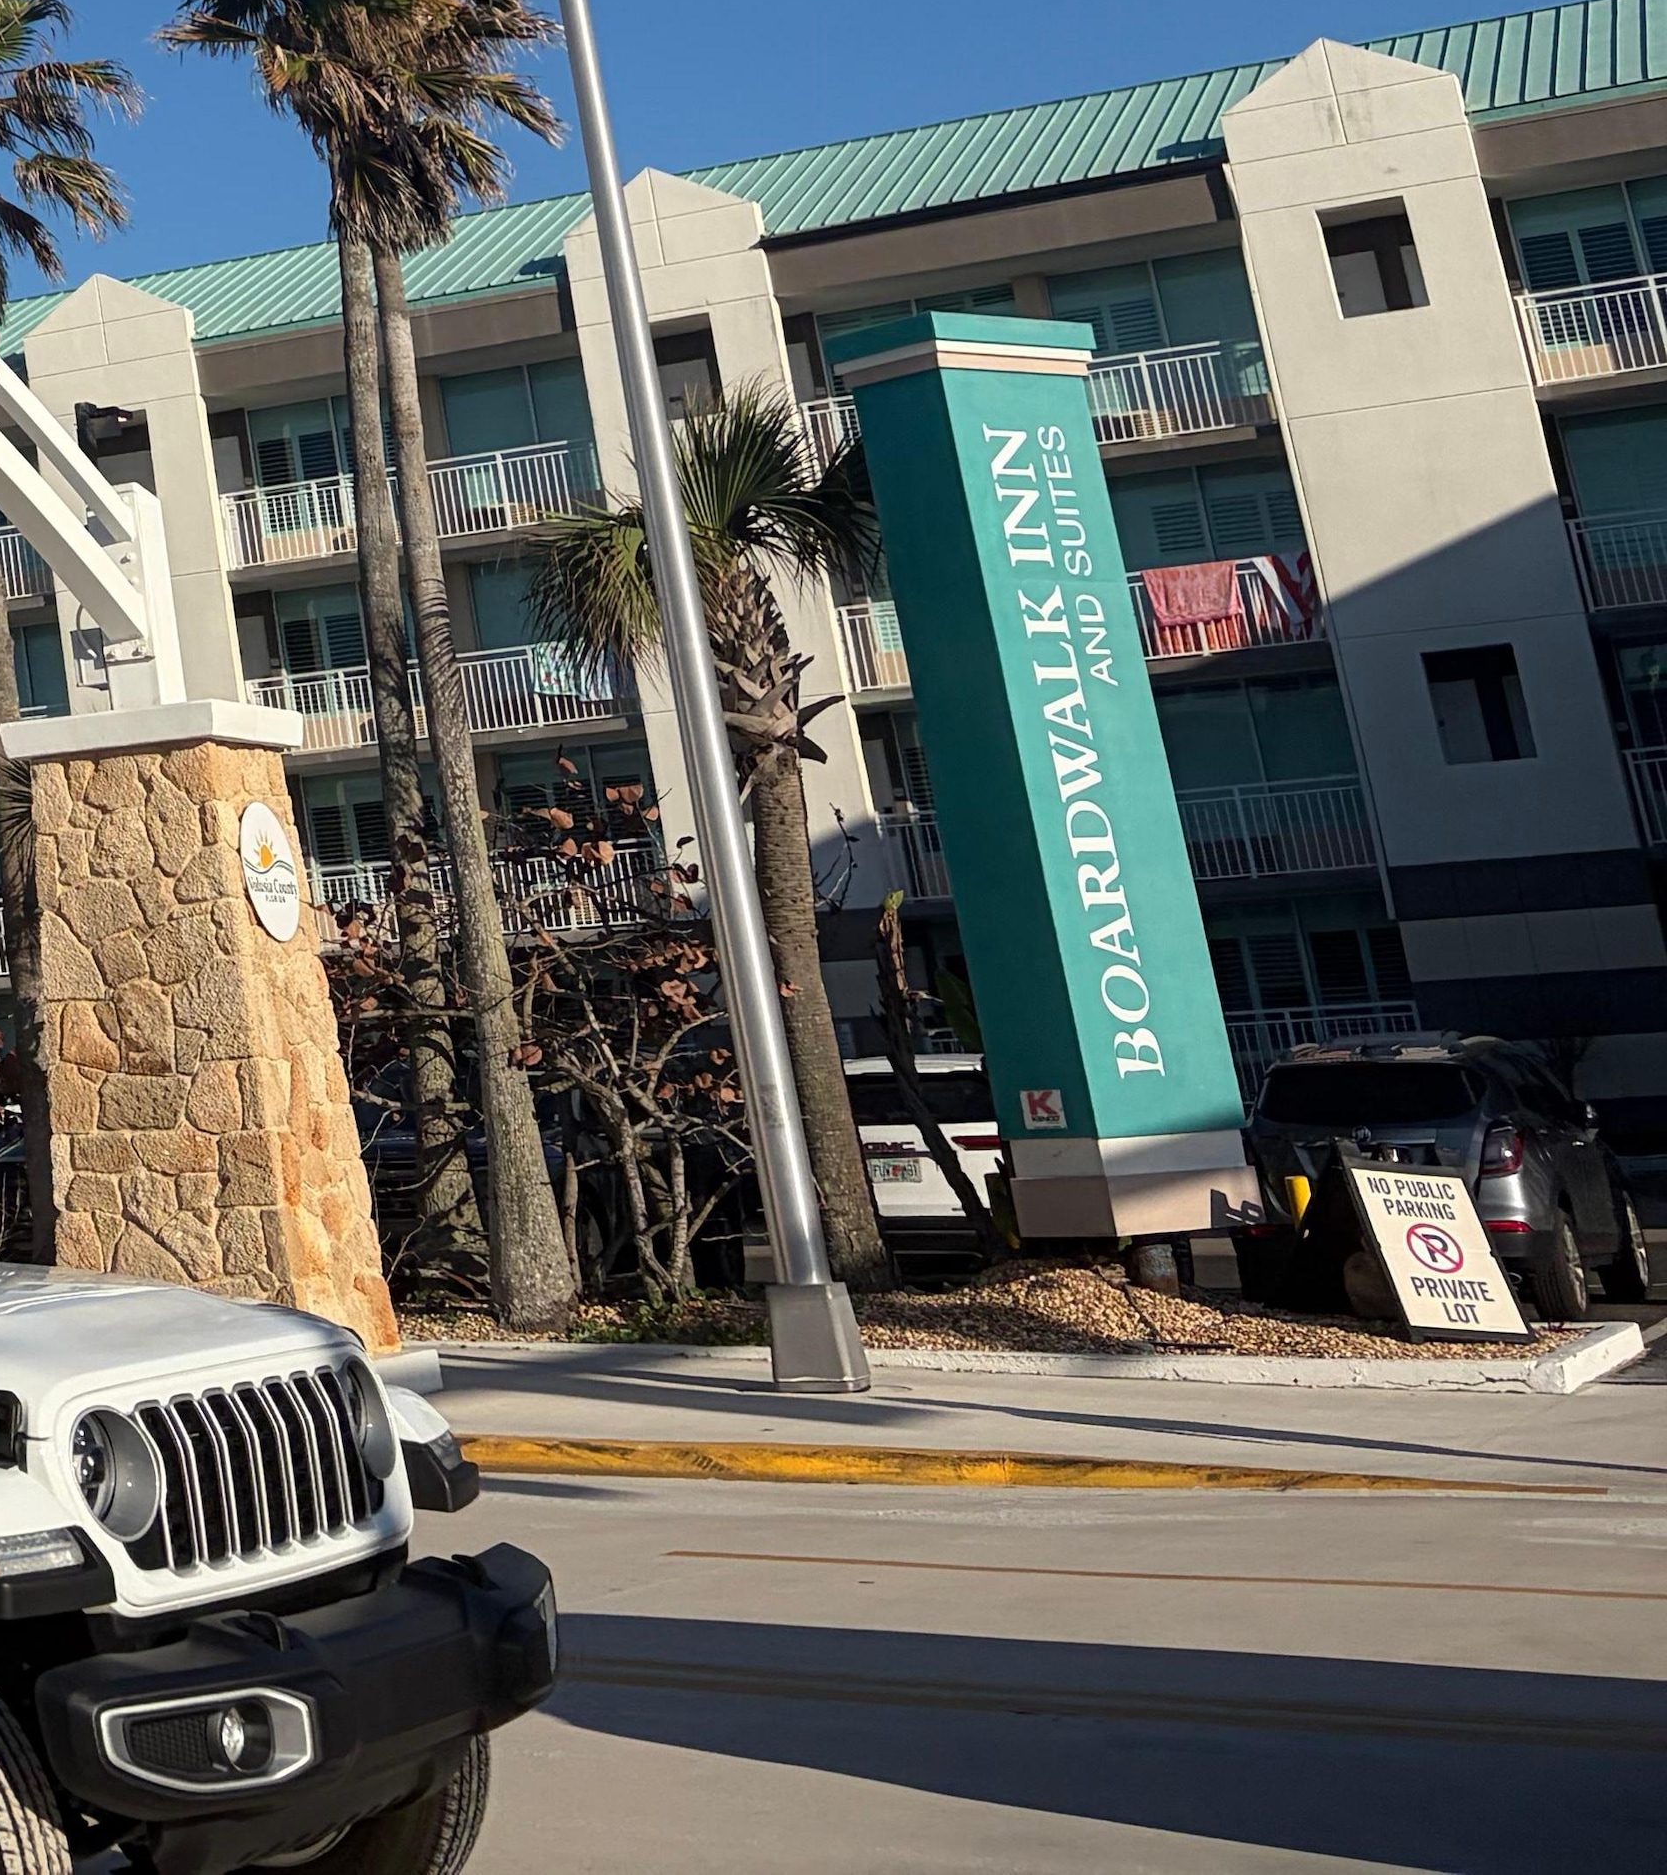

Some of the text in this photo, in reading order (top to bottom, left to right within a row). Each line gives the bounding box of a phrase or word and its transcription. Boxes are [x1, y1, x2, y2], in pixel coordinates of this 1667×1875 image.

[1037, 424, 1119, 687] AND SUITES
[981, 422, 1167, 1080] BOARDWALK INN
[1366, 1176, 1456, 1201] NO PUBLIC
[1382, 1198, 1456, 1221] PARKING
[1410, 1276, 1495, 1303] PRIVATE
[1441, 1302, 1481, 1325] LOT
